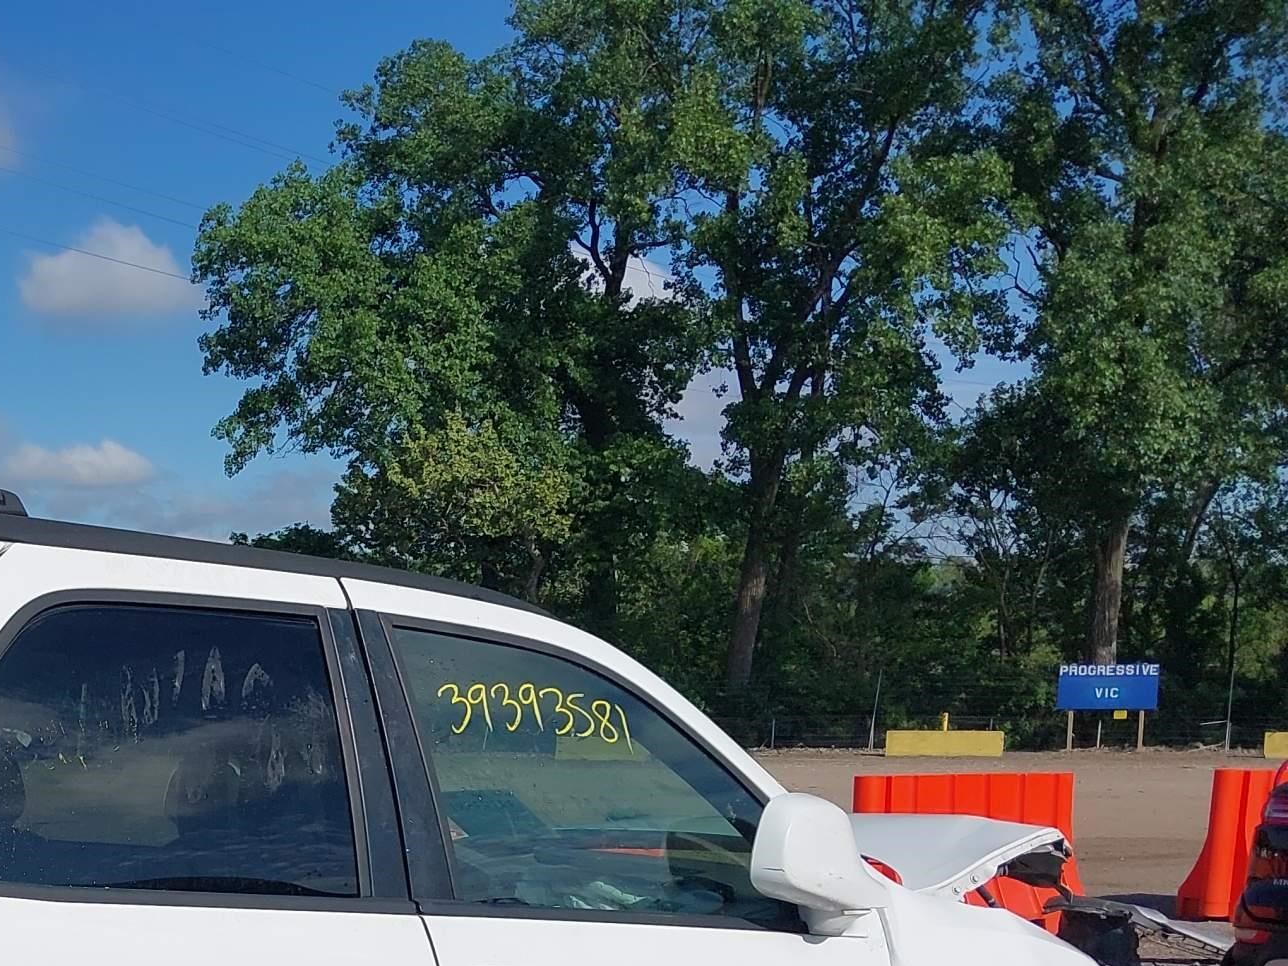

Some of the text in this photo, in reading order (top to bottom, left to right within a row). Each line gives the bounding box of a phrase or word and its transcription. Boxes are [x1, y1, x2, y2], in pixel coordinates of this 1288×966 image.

[1059, 664, 1160, 676] PROGRESSIVE
[1095, 688, 1119, 698] VIC
[437, 682, 634, 755] 39393581
